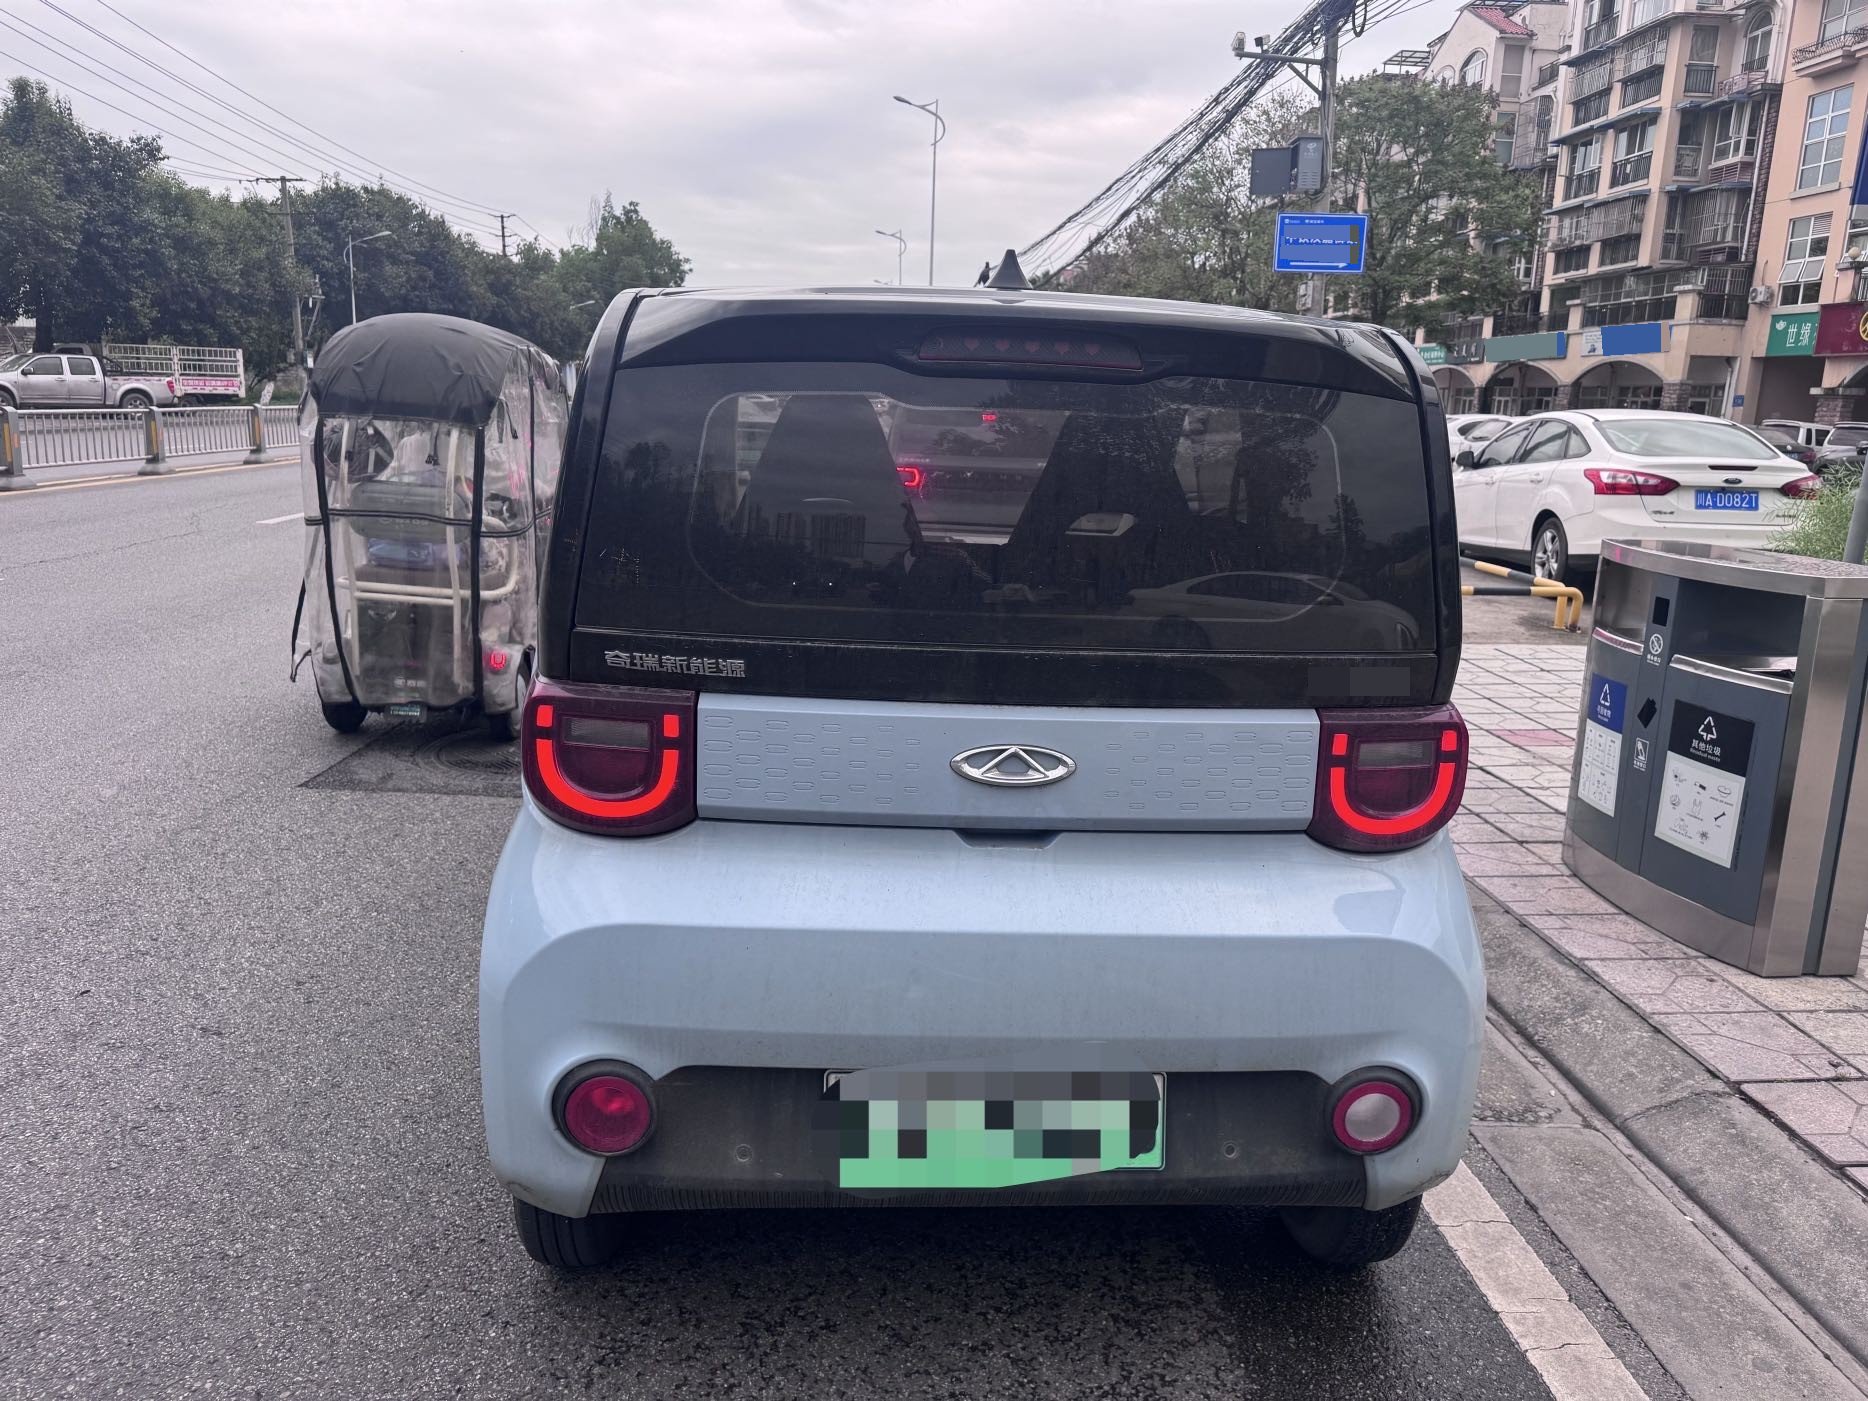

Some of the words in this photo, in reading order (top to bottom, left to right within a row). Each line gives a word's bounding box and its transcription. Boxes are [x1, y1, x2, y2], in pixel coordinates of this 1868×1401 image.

[604, 650, 746, 678] 奇瑞新能源
[1691, 739, 1721, 757] 其他垃圾
